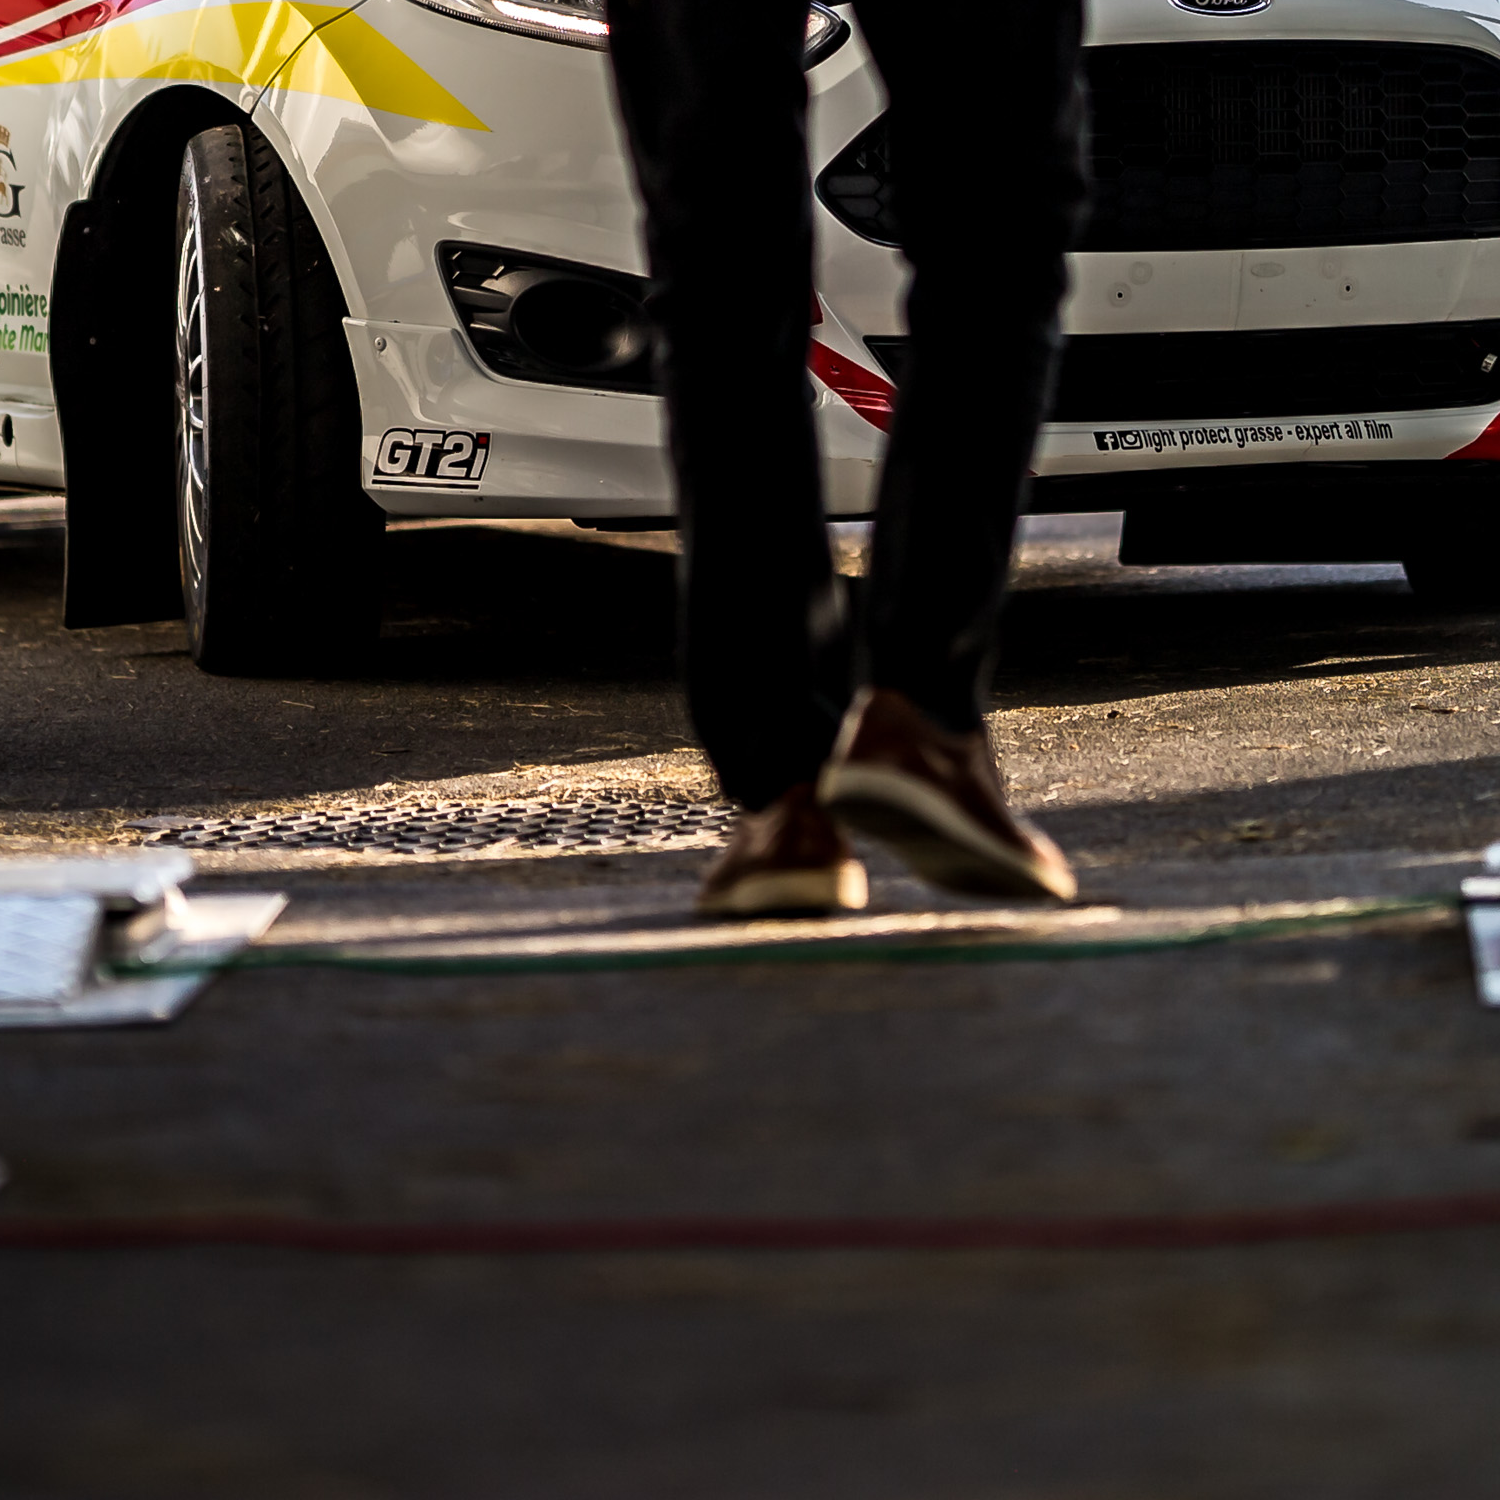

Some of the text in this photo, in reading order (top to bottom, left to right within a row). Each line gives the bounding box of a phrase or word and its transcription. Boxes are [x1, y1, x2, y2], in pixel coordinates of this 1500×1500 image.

[19, 324, 49, 353] Mar
[1143, 430, 1177, 454] light
[1179, 426, 1233, 451] protect
[1235, 425, 1284, 449] grasse
[1295, 421, 1343, 446] expert
[1345, 419, 1364, 440] all
[1364, 419, 1394, 440] film
[377, 430, 489, 479] GT2i
